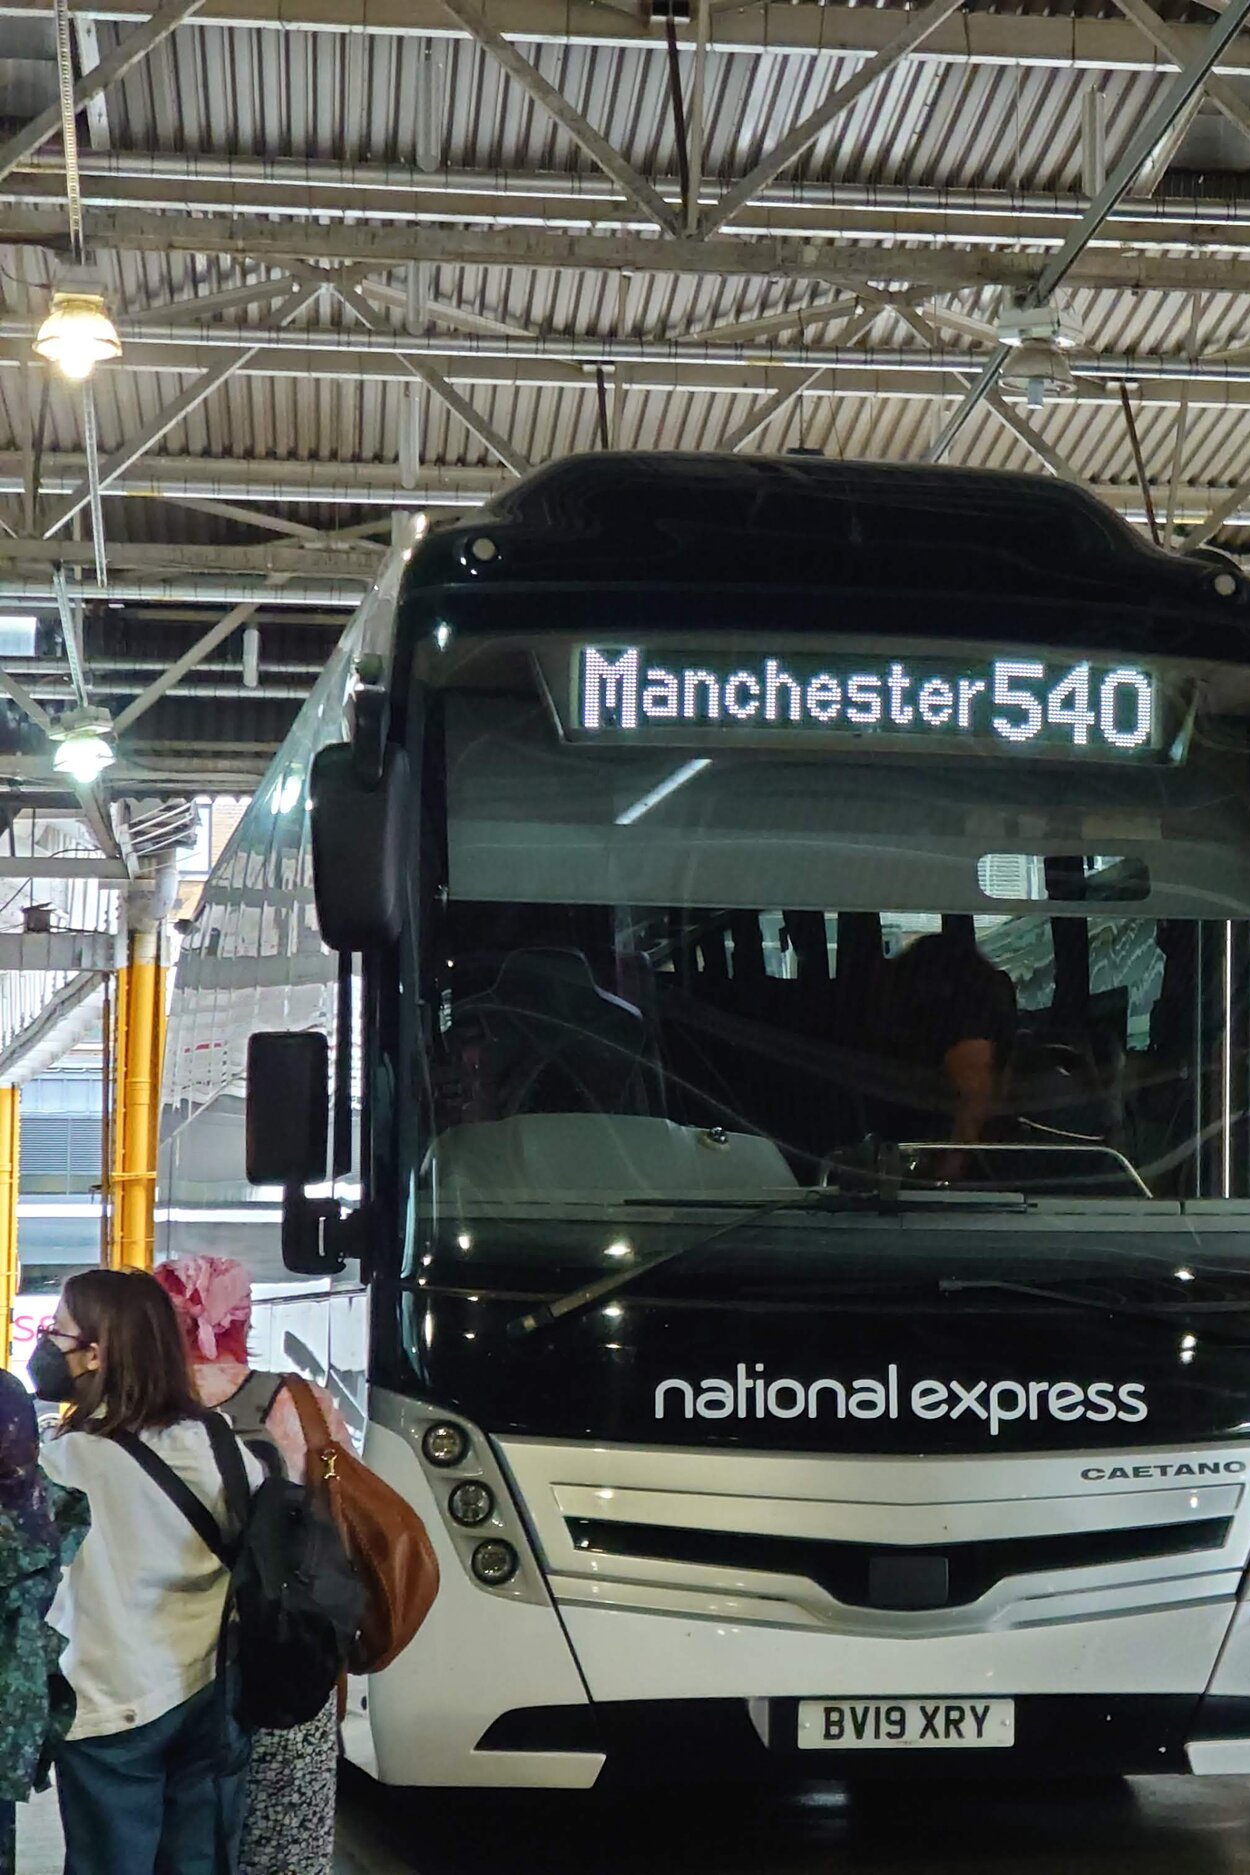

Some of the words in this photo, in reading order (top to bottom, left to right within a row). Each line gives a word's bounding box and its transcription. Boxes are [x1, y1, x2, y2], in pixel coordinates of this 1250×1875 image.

[583, 645, 986, 730] Manchester
[992, 661, 1153, 748] 540
[655, 1362, 898, 1420] national
[911, 1379, 1148, 1436] express
[1080, 1461, 1247, 1481] CAETANO
[823, 1705, 906, 1741] BV19
[919, 1704, 990, 1740] XRY
